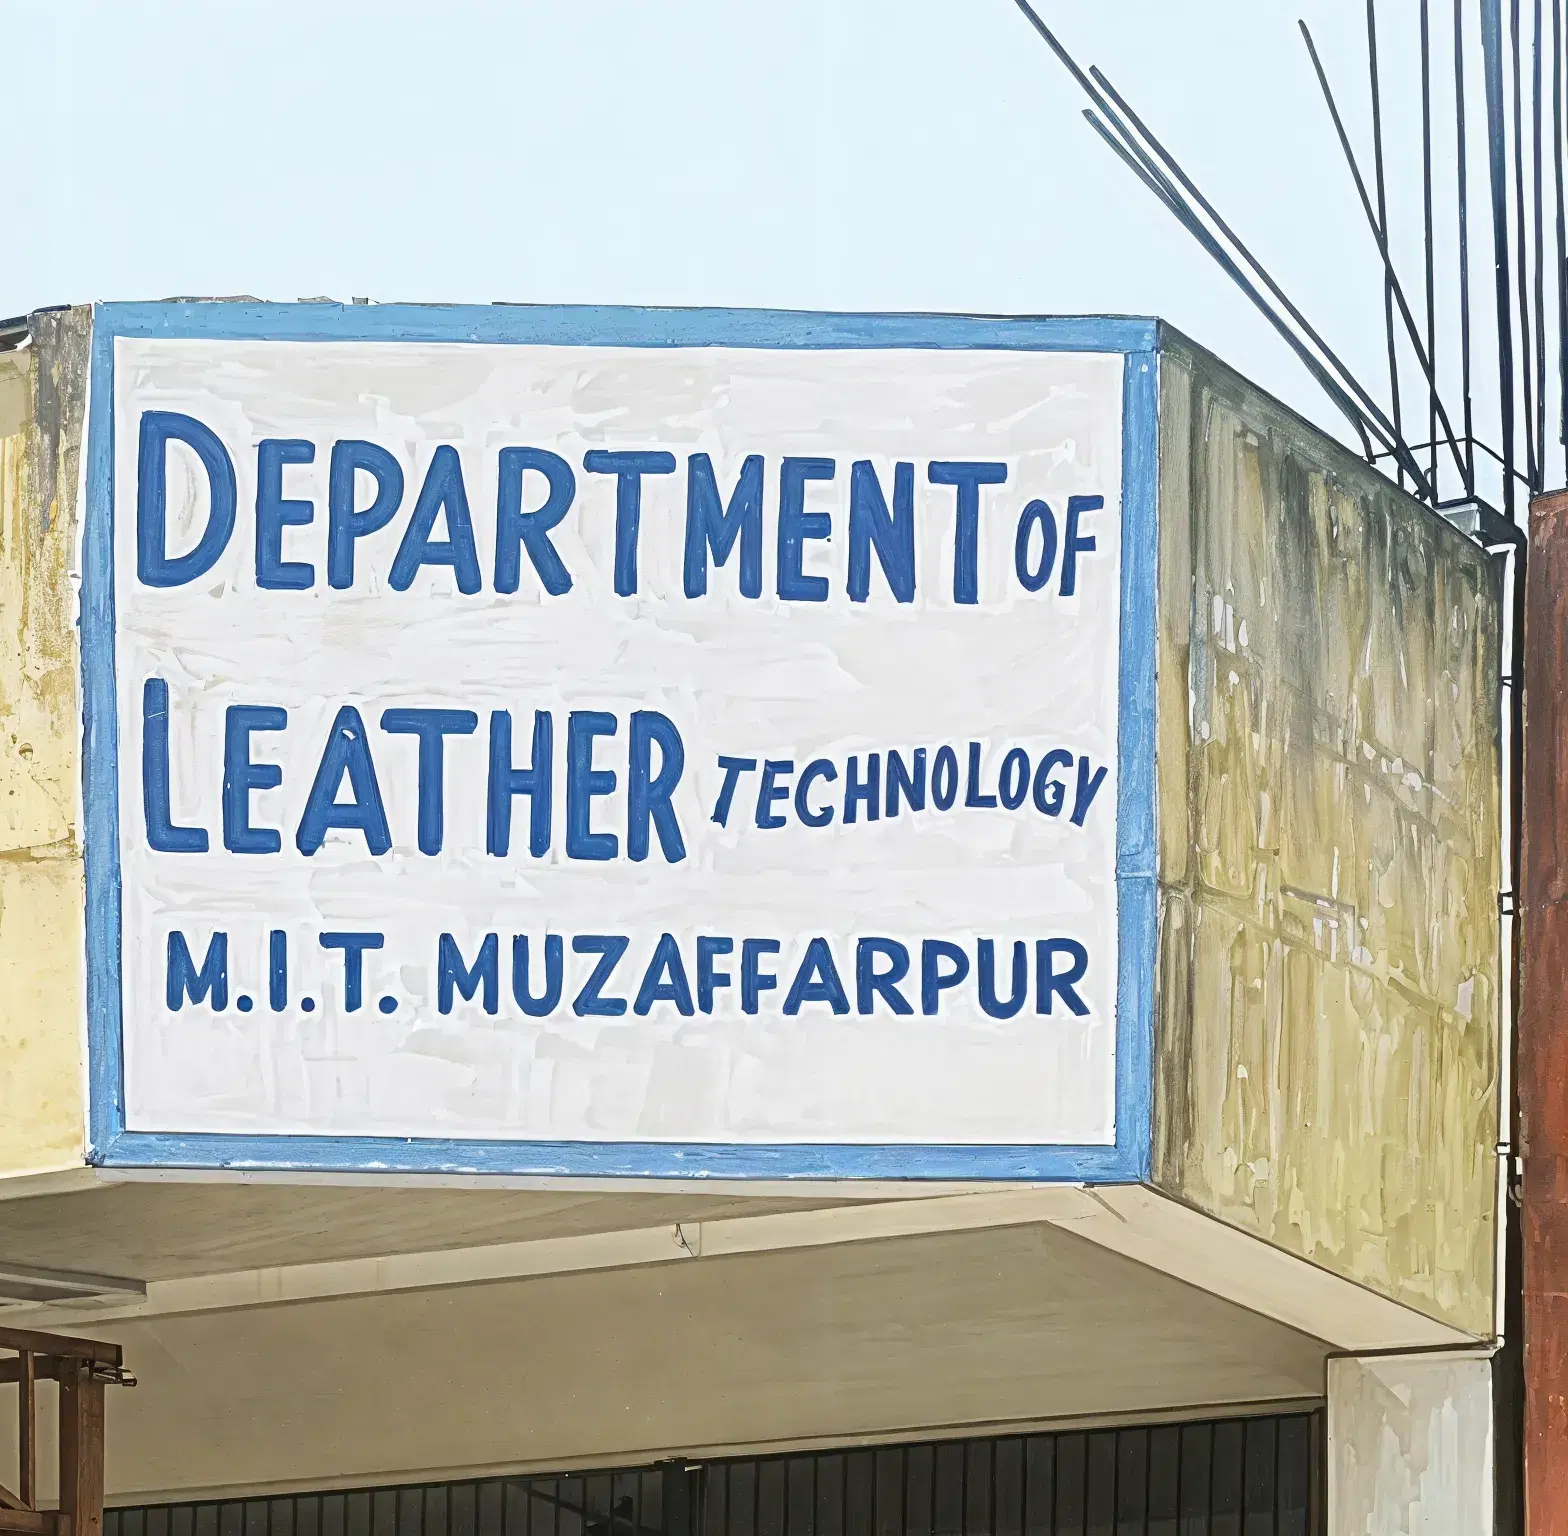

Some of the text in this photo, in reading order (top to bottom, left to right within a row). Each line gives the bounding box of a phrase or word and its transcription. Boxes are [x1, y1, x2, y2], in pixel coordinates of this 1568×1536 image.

[135, 409, 1106, 606] DEPARTMENT OF
[141, 676, 1108, 865] LEATHER TECHNOLOGY
[165, 928, 1091, 1021] M.I.T. MUZAFFARPUR
